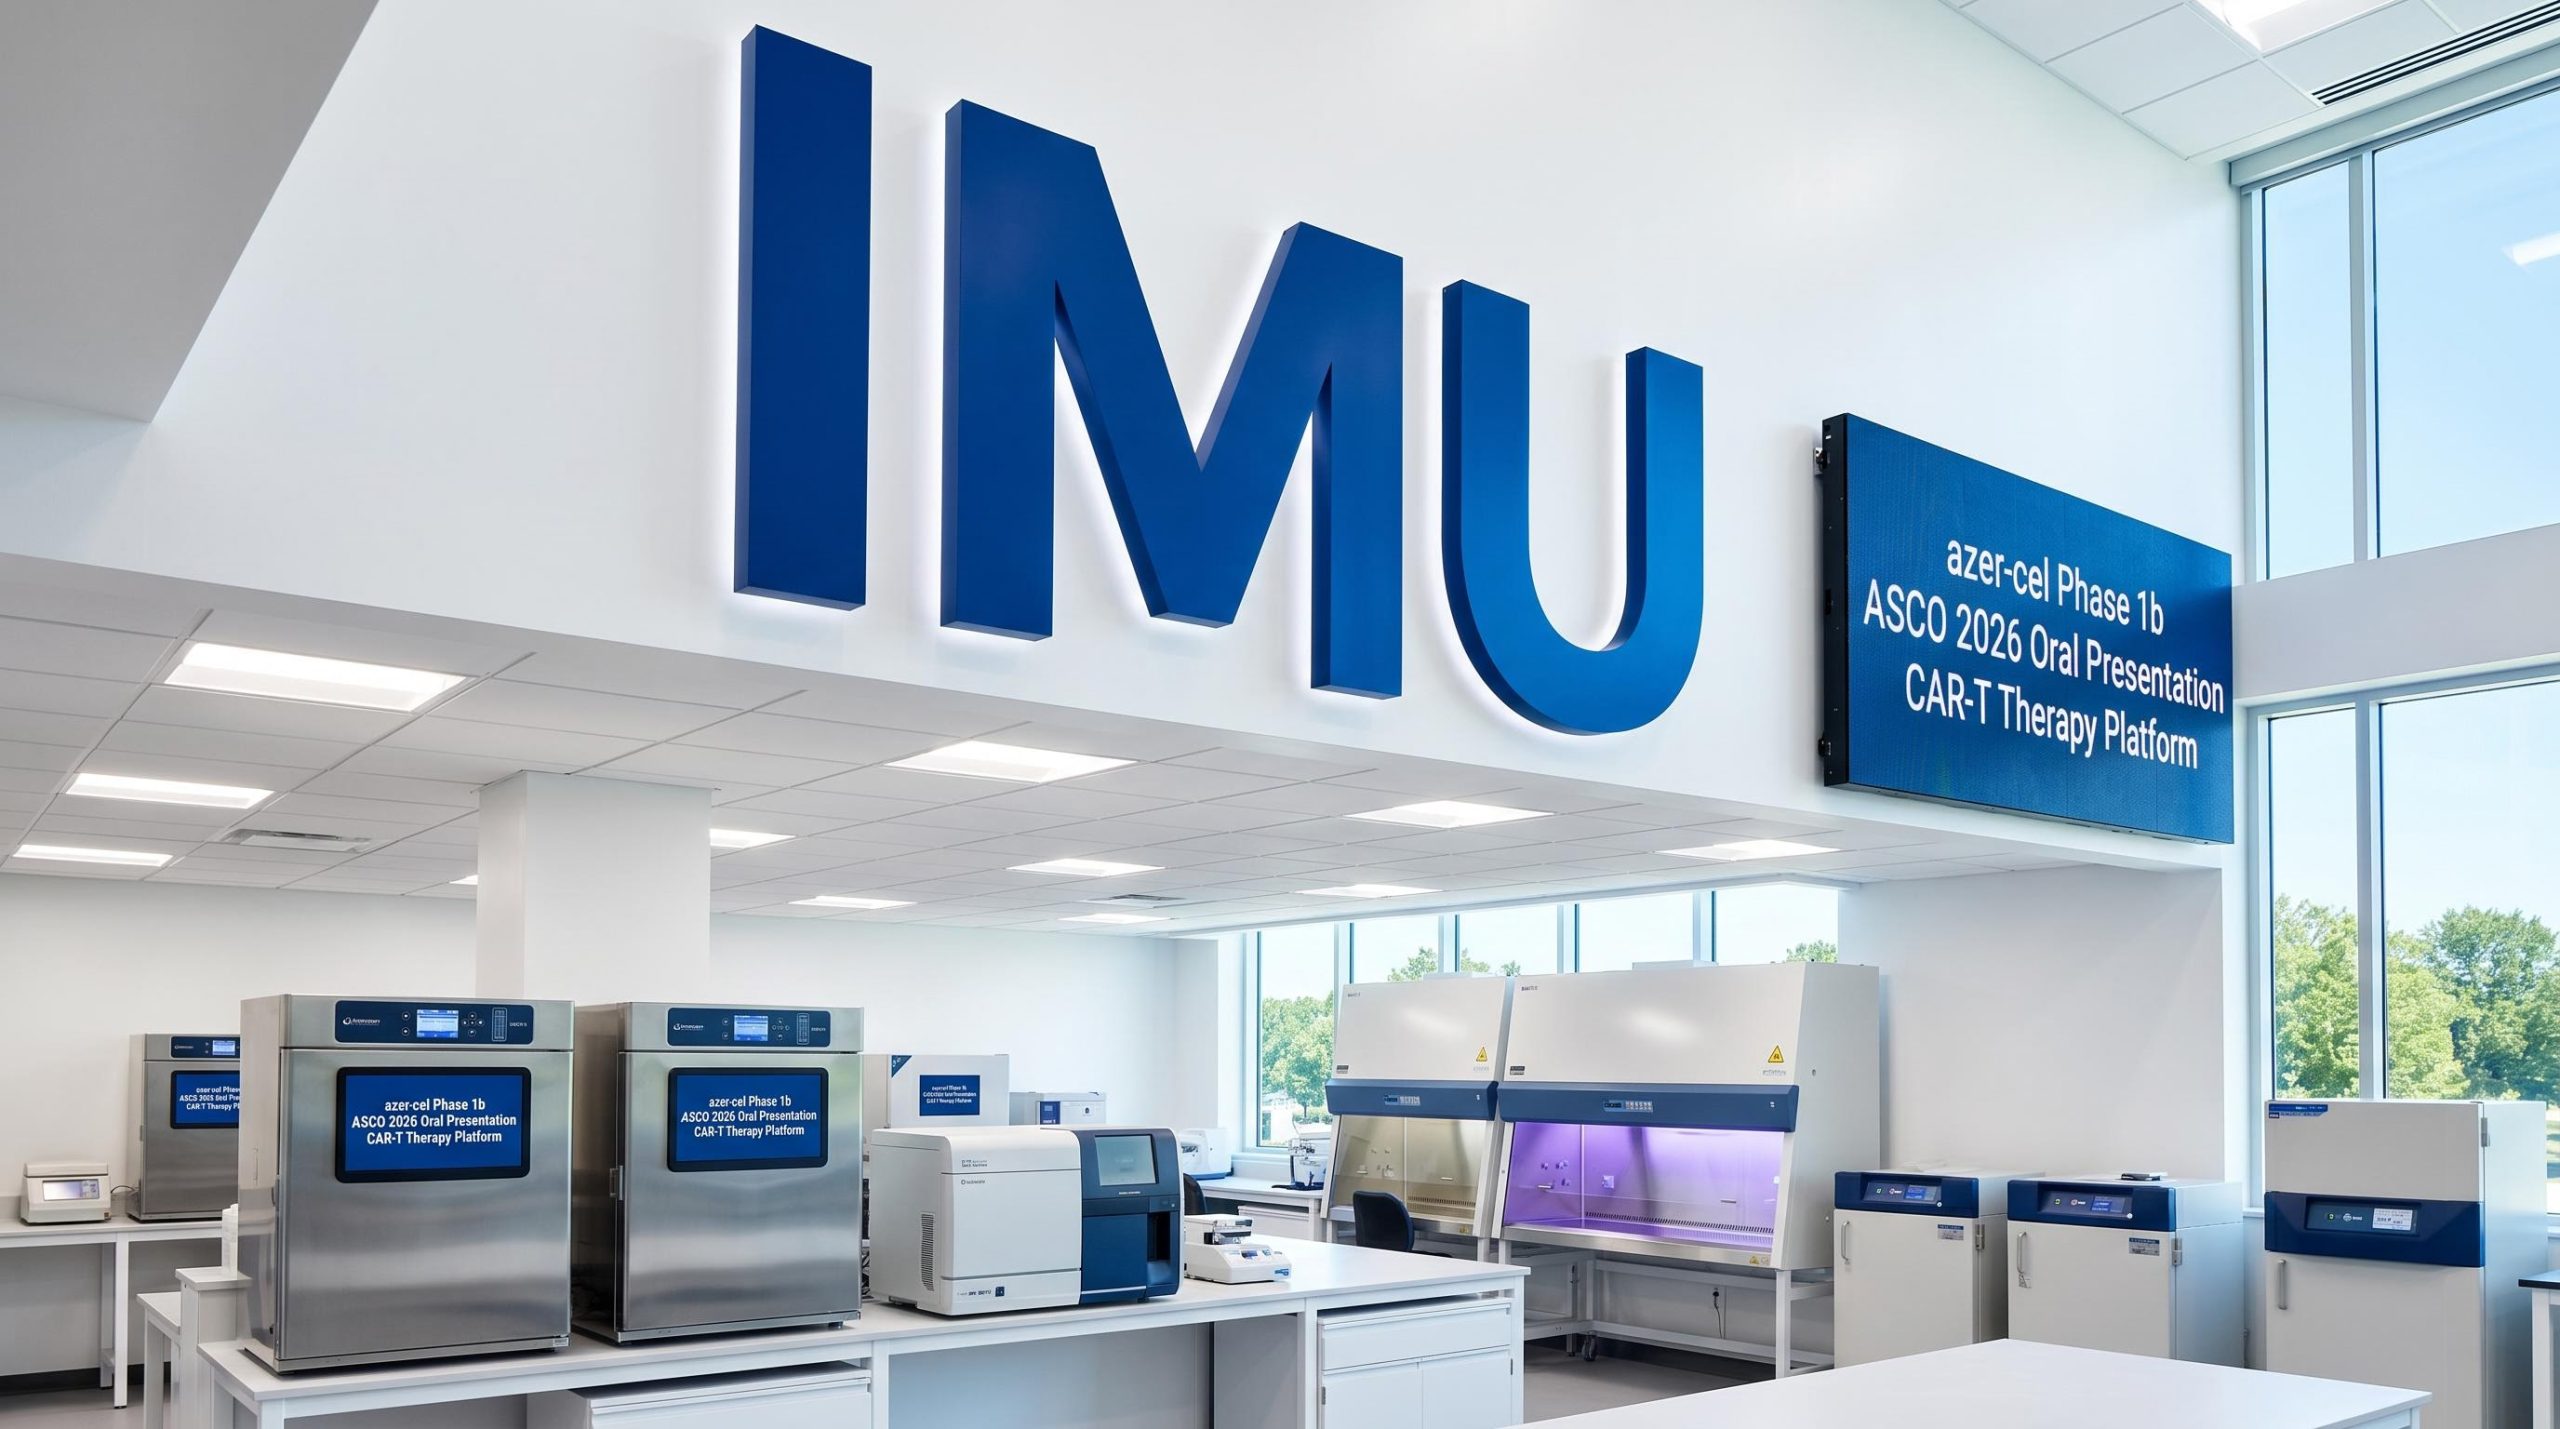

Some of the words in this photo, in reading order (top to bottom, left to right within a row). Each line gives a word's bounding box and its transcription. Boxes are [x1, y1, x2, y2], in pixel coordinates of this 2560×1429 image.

[734, 25, 1703, 736] IMU
[1947, 540, 2049, 602] azer-cel
[2058, 563, 2130, 626] Phase
[2137, 591, 2164, 636] 1b
[1863, 579, 1947, 643] ASCO
[1956, 604, 2022, 662] 2026
[2030, 624, 2078, 678] Oral
[2087, 640, 2224, 714] Presentation
[1905, 663, 1992, 725] CAR-T
[1998, 684, 2098, 758] Therapy
[2104, 709, 2198, 769] Platform
[385, 1099, 430, 1111] azer-cel
[433, 1098, 468, 1111] Phase
[472, 1098, 485, 1110] 1b
[709, 1095, 746, 1107] azer-cel
[749, 1095, 777, 1107] Phase
[780, 1094, 791, 1106] 1b
[352, 1115, 385, 1128] ASCO
[389, 1115, 417, 1127] 2026
[421, 1115, 443, 1127] Oral
[447, 1114, 516, 1126] Presentation
[681, 1111, 709, 1122] ASCO
[712, 1111, 735, 1122] 2026
[738, 1110, 756, 1121] Oral
[760, 1110, 817, 1120] Presentation
[367, 1132, 403, 1144] CAR-T
[406, 1131, 451, 1146] Therapy
[455, 1130, 502, 1142] Platform
[694, 1126, 724, 1137] CAR-T
[726, 1125, 762, 1139] Therapy
[765, 1124, 804, 1135] Platform
